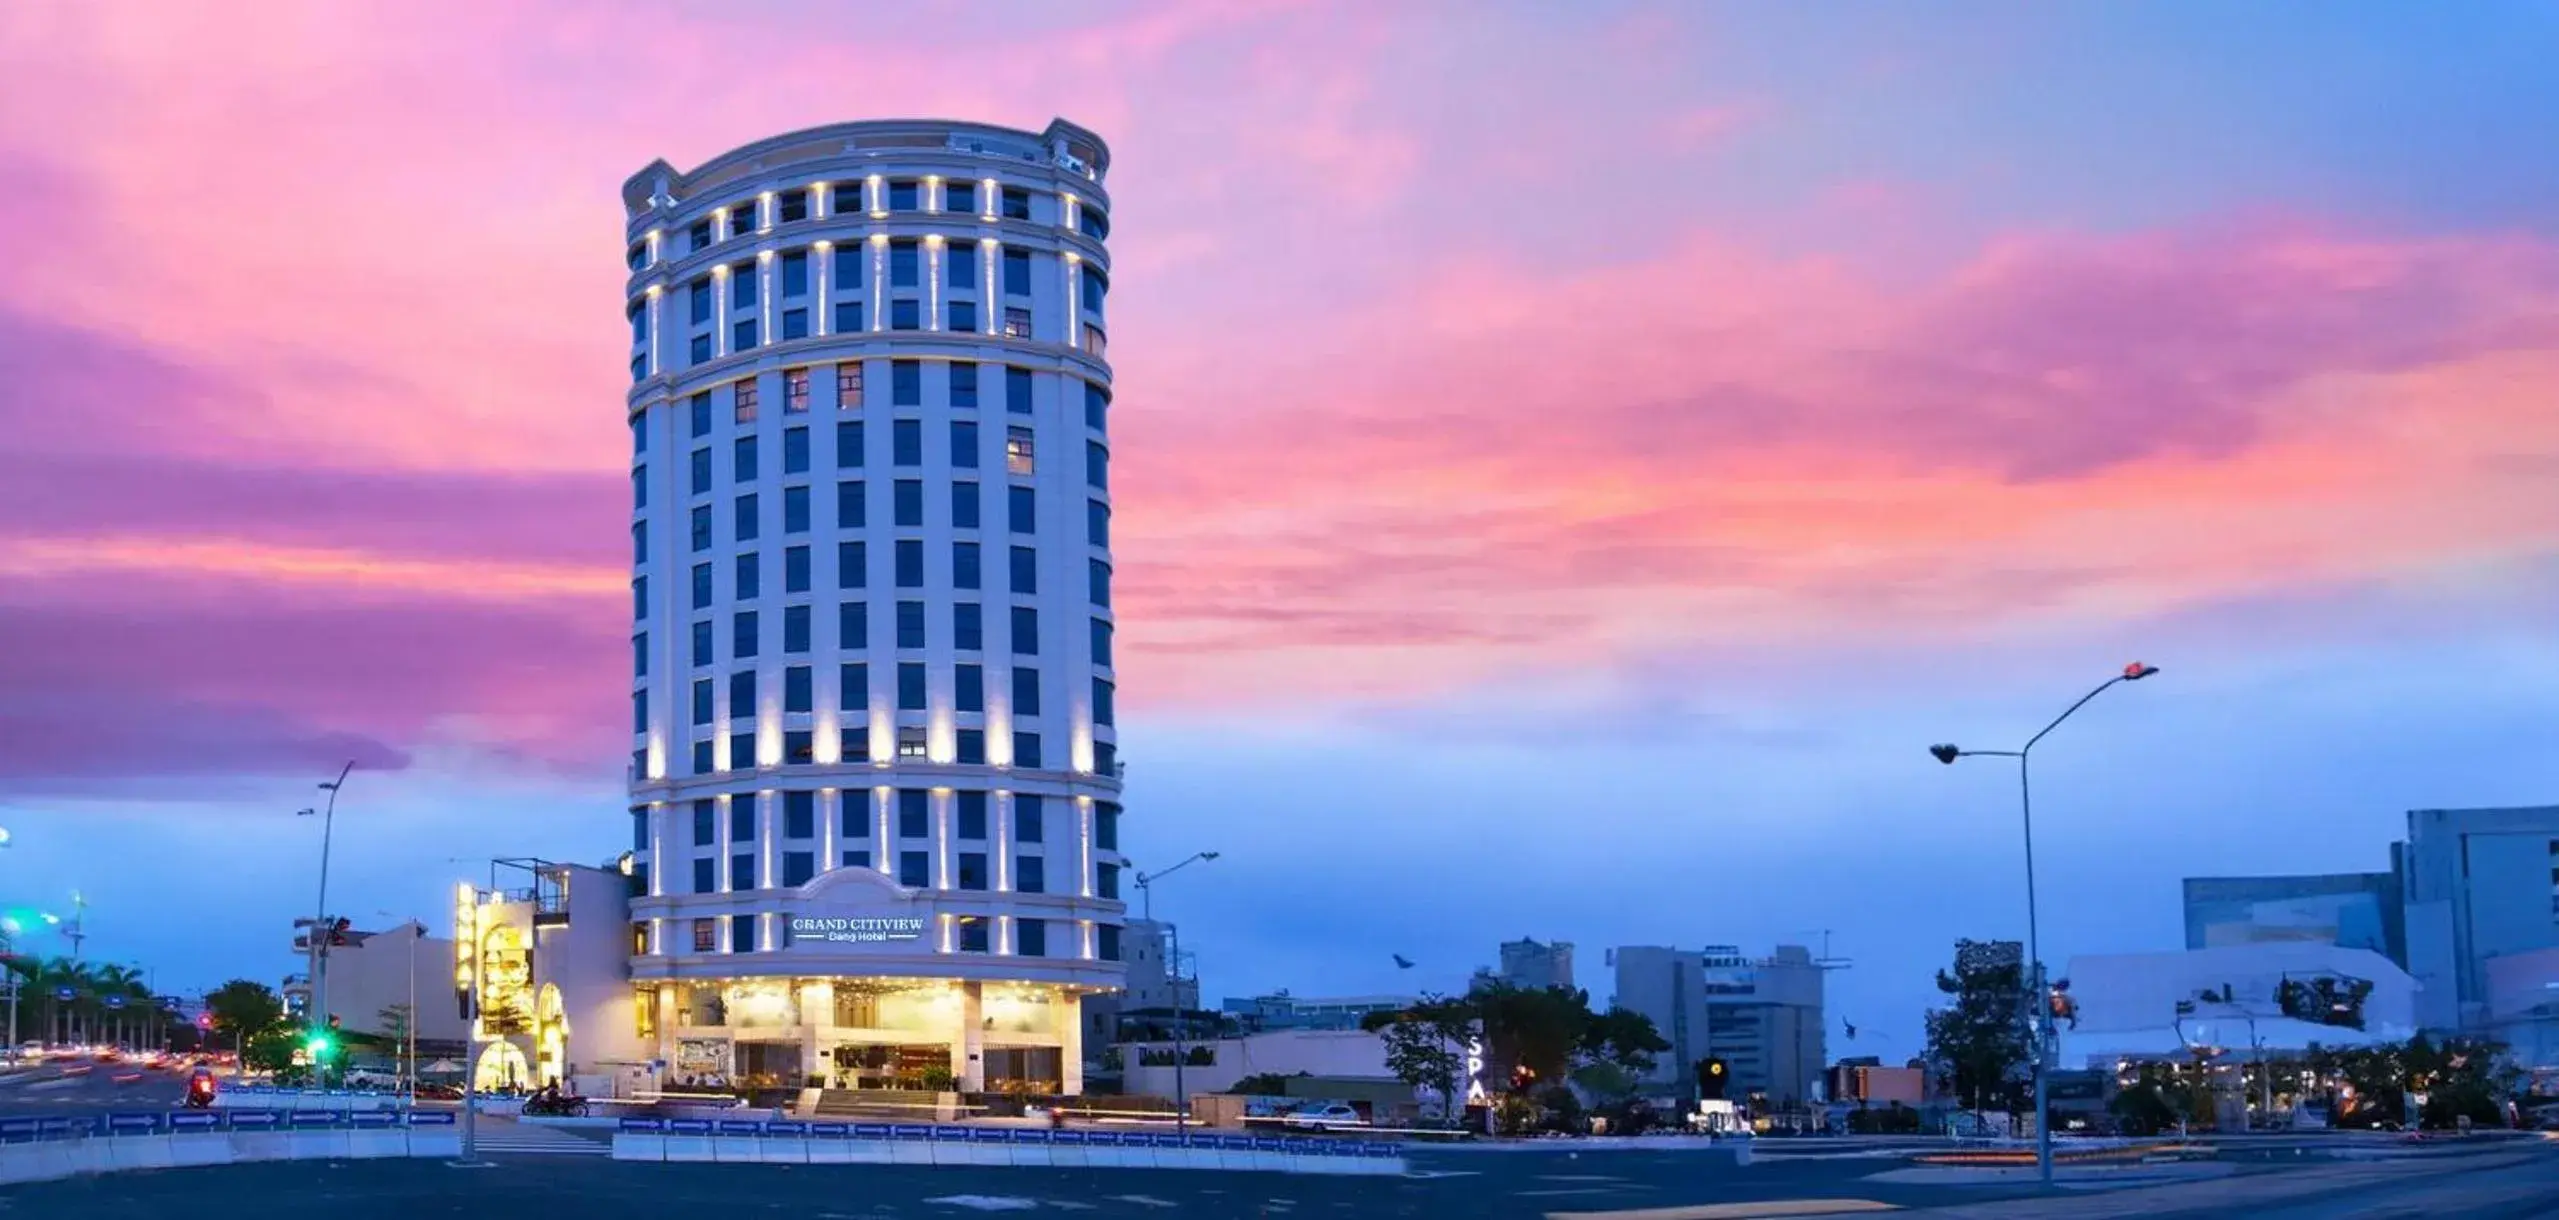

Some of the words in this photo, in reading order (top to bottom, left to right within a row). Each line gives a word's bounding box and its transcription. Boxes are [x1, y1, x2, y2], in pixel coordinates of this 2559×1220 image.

[793, 919, 847, 930] GRAND
[850, 919, 923, 930] CITIVIEW
[858, 931, 886, 941] Hotel
[1468, 1036, 1485, 1105] SPA
